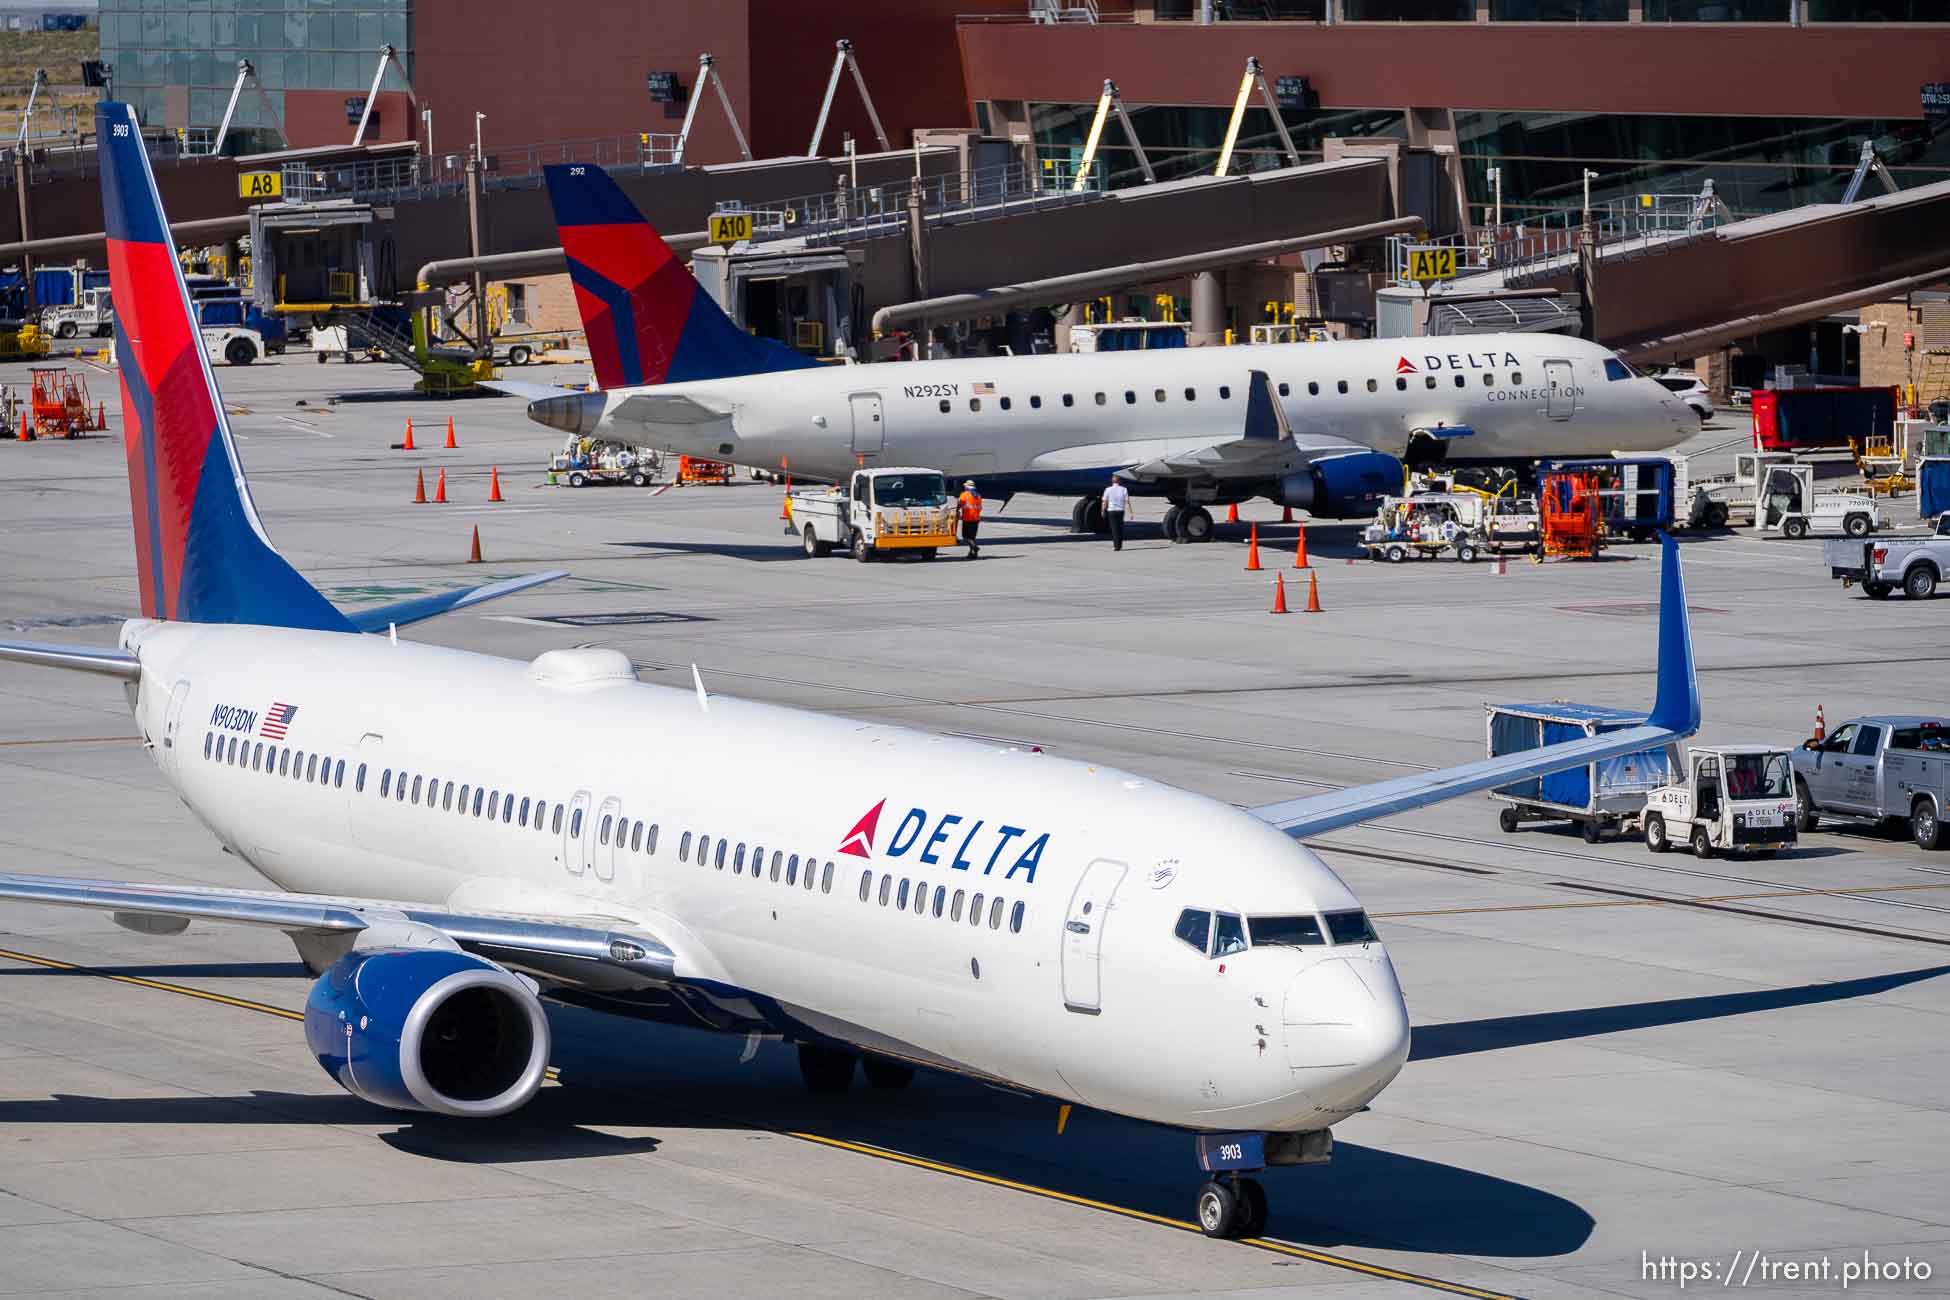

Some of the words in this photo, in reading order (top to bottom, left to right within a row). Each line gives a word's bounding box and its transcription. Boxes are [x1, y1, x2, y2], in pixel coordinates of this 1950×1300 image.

[112, 123, 129, 136] 3903
[570, 167, 585, 176] 292
[251, 175, 273, 194] A8
[718, 215, 745, 238] A10
[1416, 249, 1450, 276] A12
[1424, 351, 1521, 371] DELTA
[903, 383, 959, 398] N292SY
[1487, 386, 1585, 402] CONNECTION
[209, 703, 258, 734] N903DN
[886, 807, 1050, 884] DELTA
[1219, 1143, 1242, 1161] 3903
